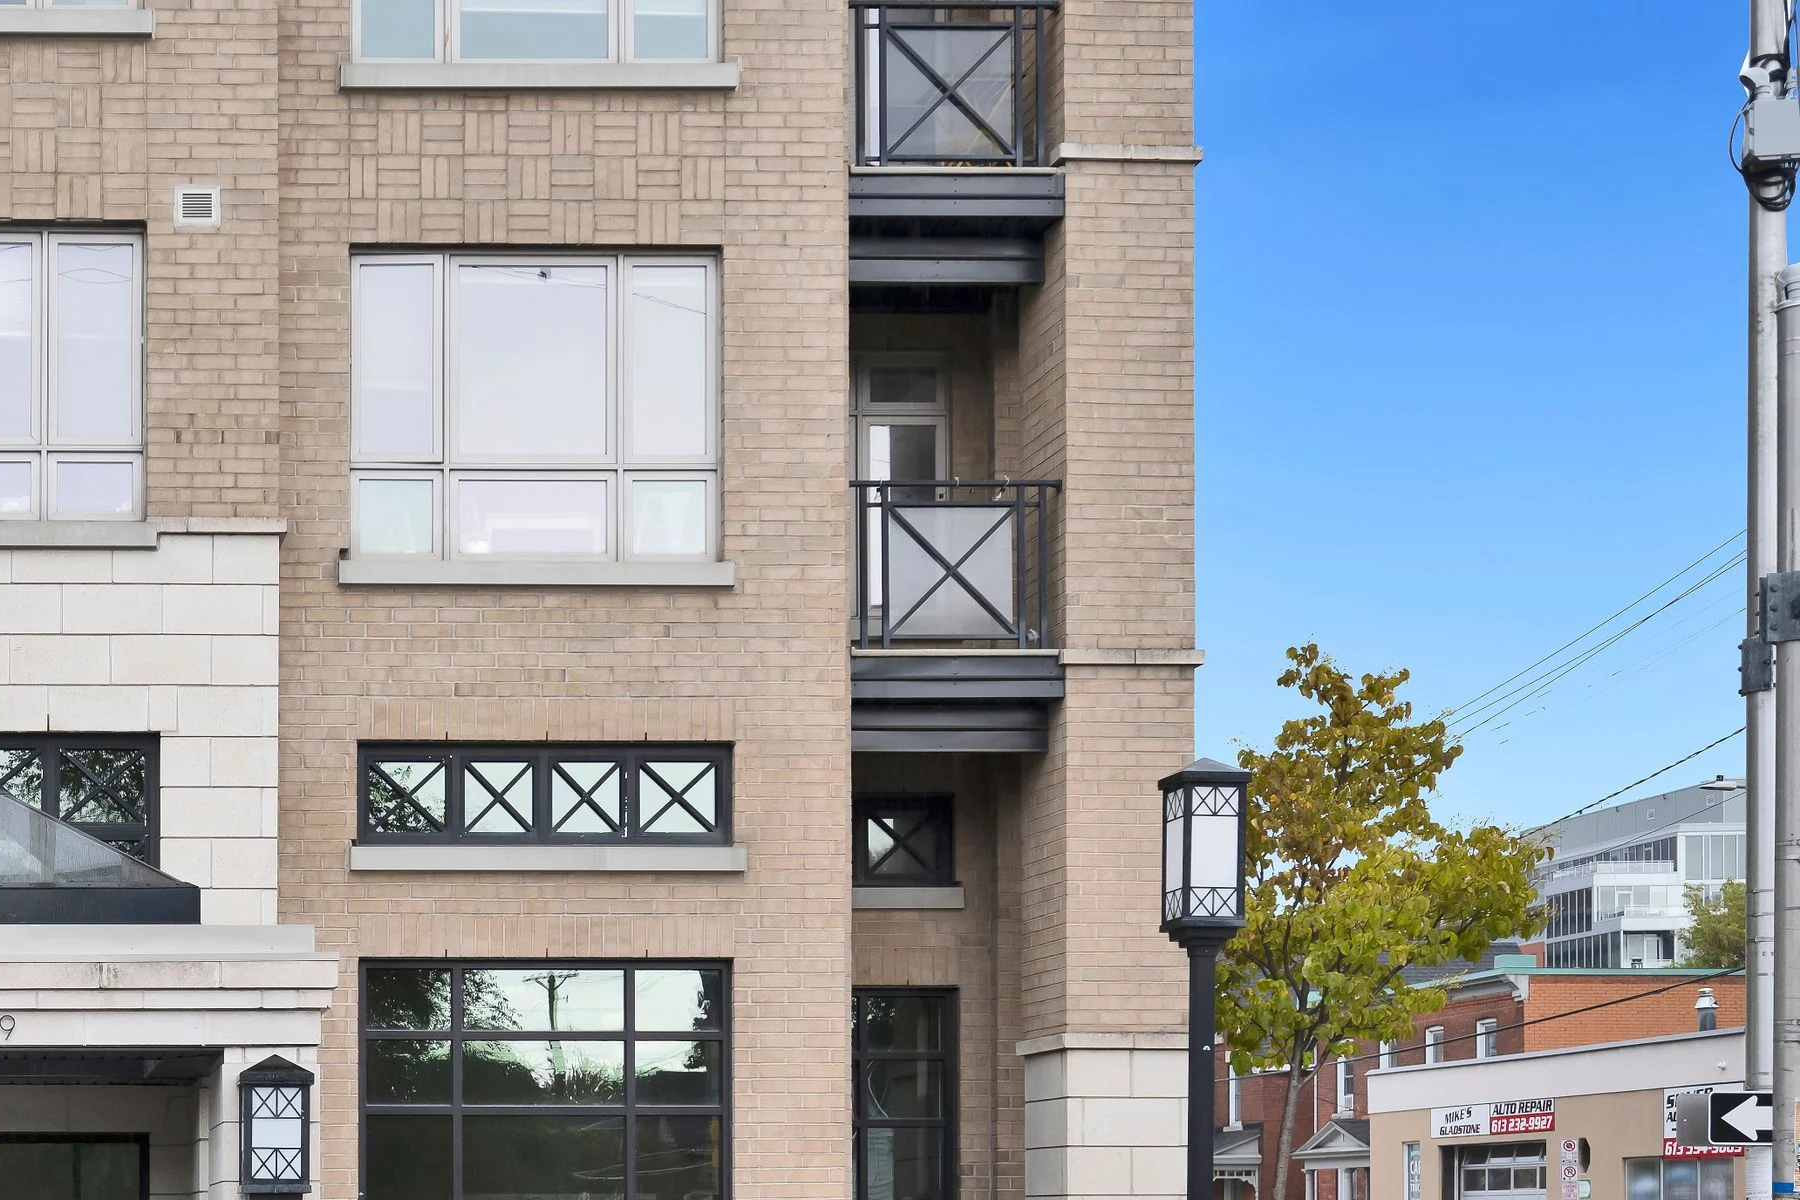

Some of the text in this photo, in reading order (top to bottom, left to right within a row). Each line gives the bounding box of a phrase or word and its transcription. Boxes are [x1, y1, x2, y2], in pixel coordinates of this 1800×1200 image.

[1492, 1099, 1553, 1116] AUTO REPAIR
[1444, 1107, 1473, 1125] MIKE'S
[1440, 1123, 1481, 1136] GLADSTONE
[1491, 1119, 1507, 1133] 613
